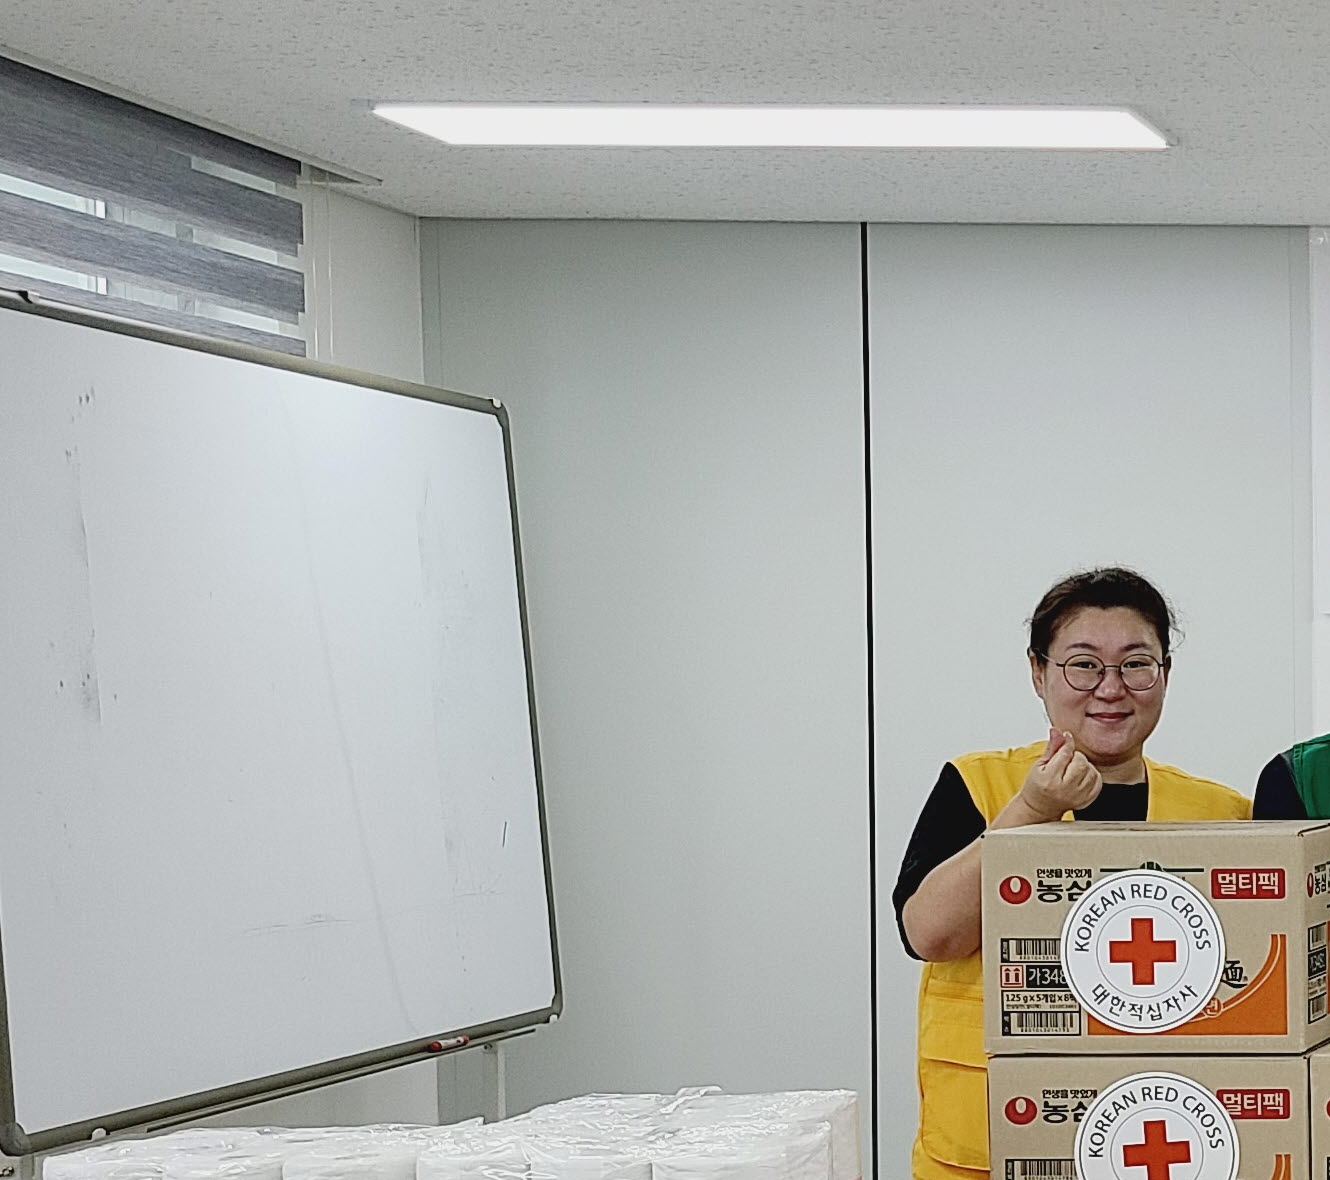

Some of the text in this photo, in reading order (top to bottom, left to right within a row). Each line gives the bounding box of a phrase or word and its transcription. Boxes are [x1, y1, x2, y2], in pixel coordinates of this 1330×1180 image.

[1217, 872, 1279, 896] 멀티팩
[1074, 883, 1212, 953] KOREAN RED CROSS
[1091, 983, 1199, 1022] 대한적십자사
[1088, 1085, 1225, 1158] KOREAN RED CROSS
